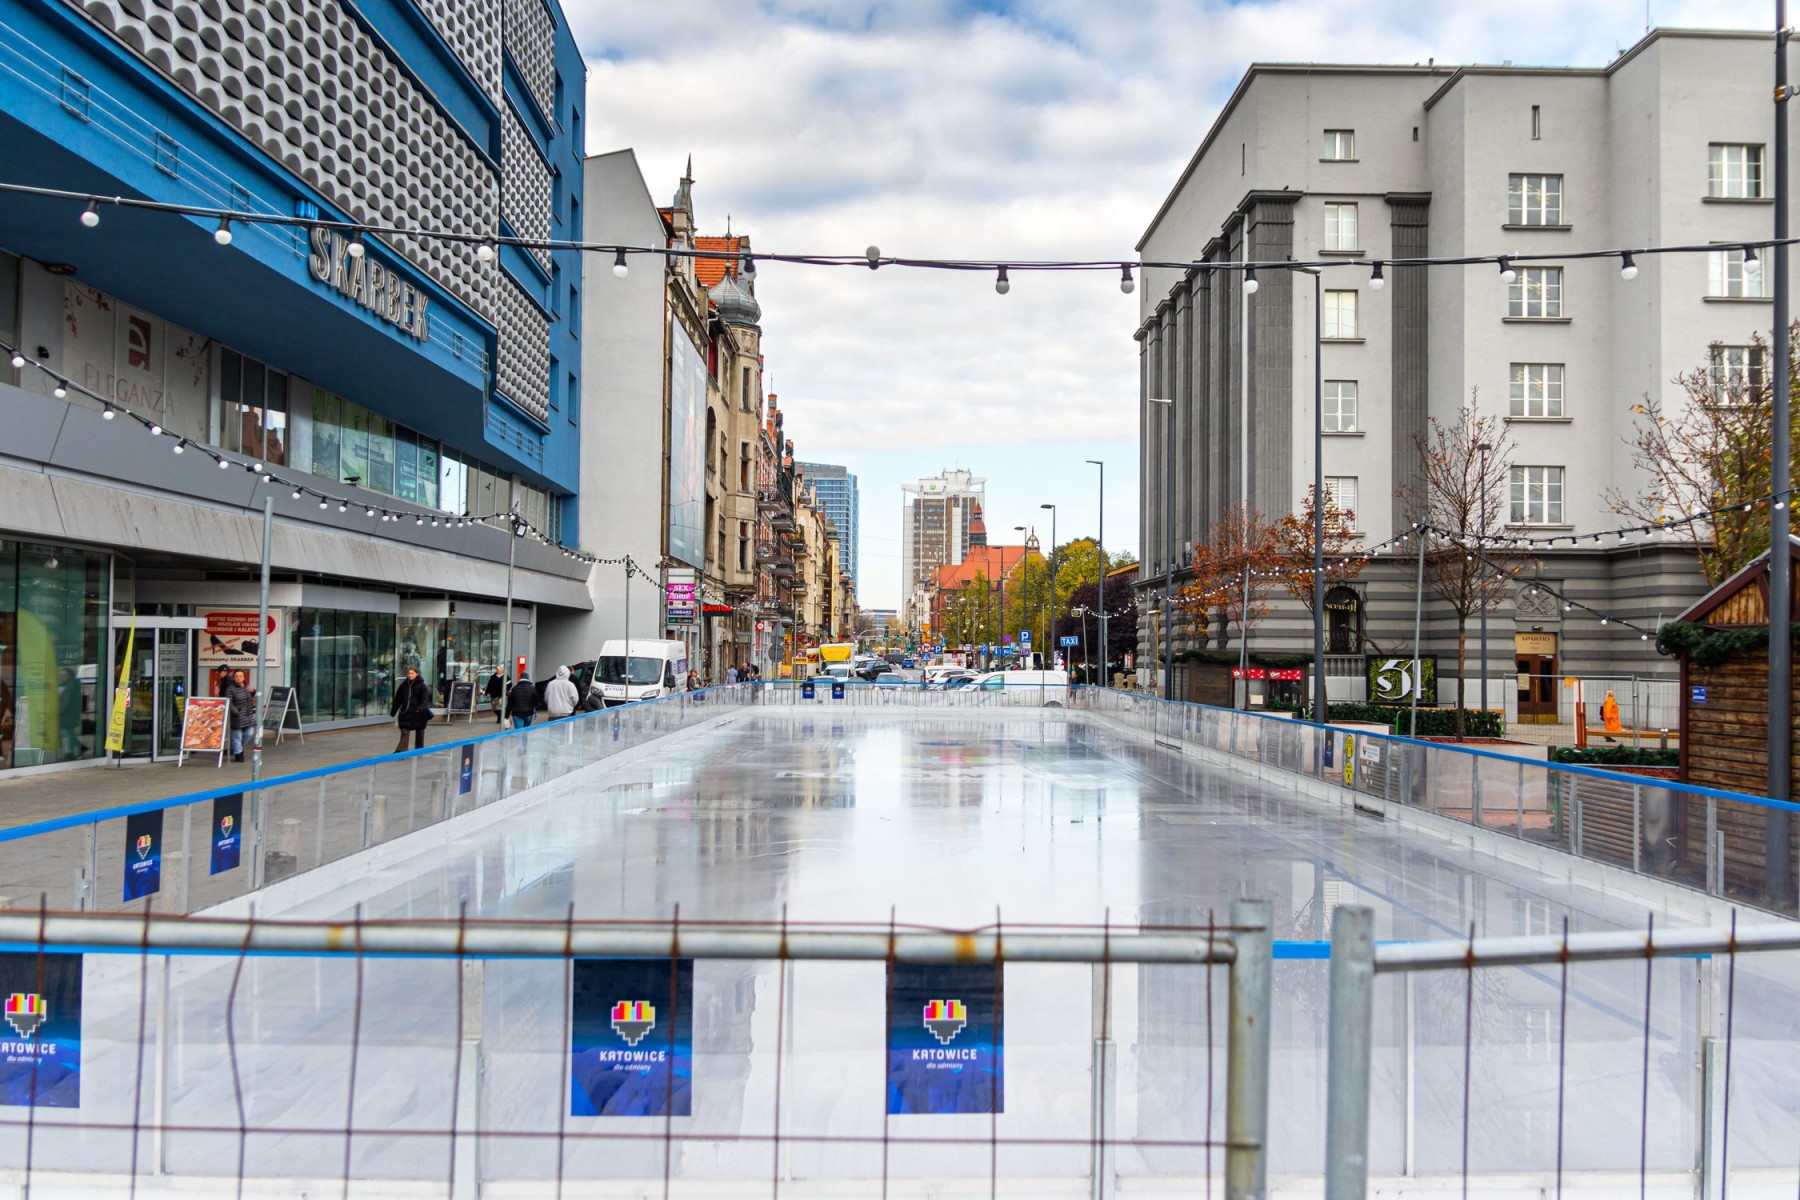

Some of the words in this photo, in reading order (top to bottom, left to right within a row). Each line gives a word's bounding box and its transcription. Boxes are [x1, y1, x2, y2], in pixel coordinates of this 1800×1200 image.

[308, 225, 430, 343] SKARBEK
[83, 362, 176, 416] ELEGANZA
[1021, 631, 1029, 641] P
[0, 1042, 56, 1054] ATOWICE
[600, 1051, 665, 1061] KATOWICE
[912, 1049, 977, 1060] KATOWICE
[937, 1062, 964, 1070] odmiany
